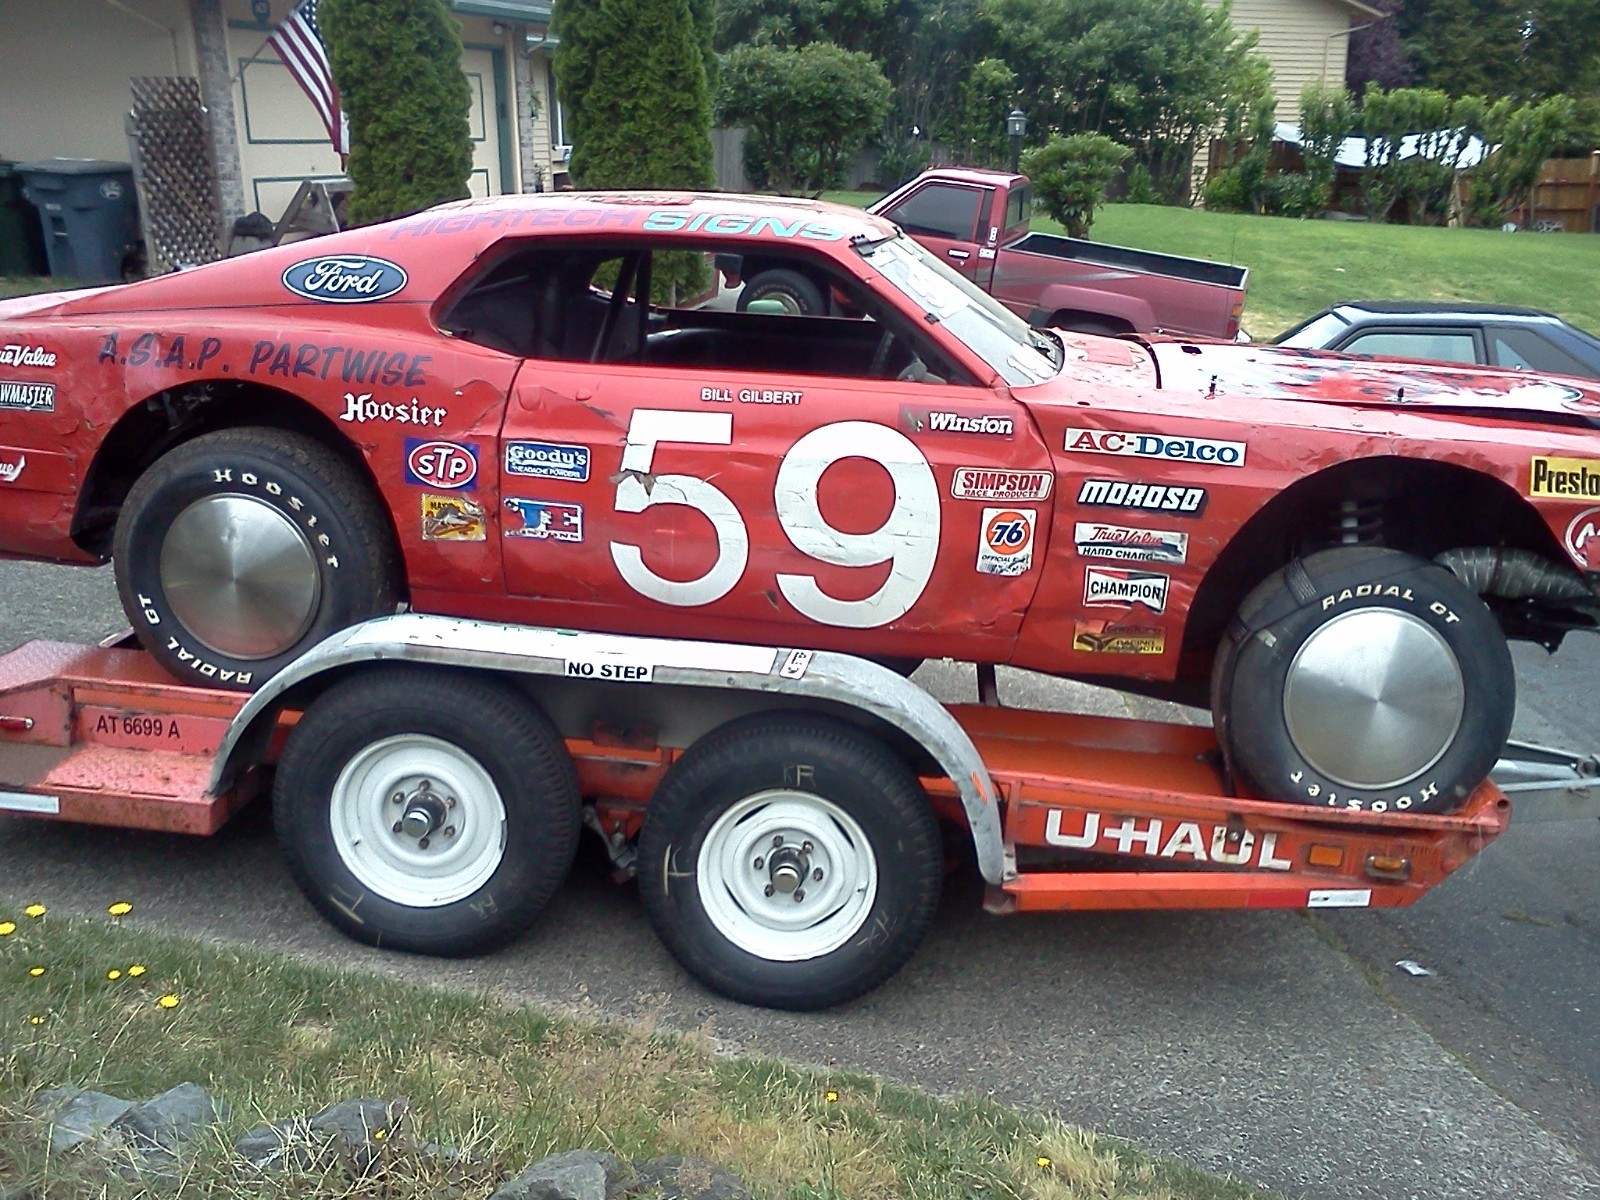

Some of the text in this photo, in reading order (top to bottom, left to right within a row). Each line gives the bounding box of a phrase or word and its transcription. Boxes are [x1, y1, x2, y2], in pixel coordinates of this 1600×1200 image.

[641, 209, 845, 242] SIGNS
[303, 258, 385, 295] Ford
[98, 332, 434, 387] A.S.A.P. PARTWISE
[339, 393, 447, 426] Hoosier
[701, 388, 803, 405] BILL GILBERT
[509, 445, 587, 466] Goody's
[1069, 430, 1240, 464] AC-Delco
[417, 448, 468, 480] STP
[962, 471, 1044, 492] SIMPSON
[993, 490, 1039, 498] PRODUCTS
[1078, 481, 1205, 512] MOROSO
[609, 407, 942, 630] 59
[993, 522, 1023, 545] 76
[1083, 546, 1113, 557] HARD
[1090, 581, 1162, 600] CHAMPION
[1322, 584, 1460, 624] RADIAL GT
[166, 635, 254, 685] RADIAL
[568, 661, 649, 679] NO STEP
[96, 714, 181, 739] AT 6699 A
